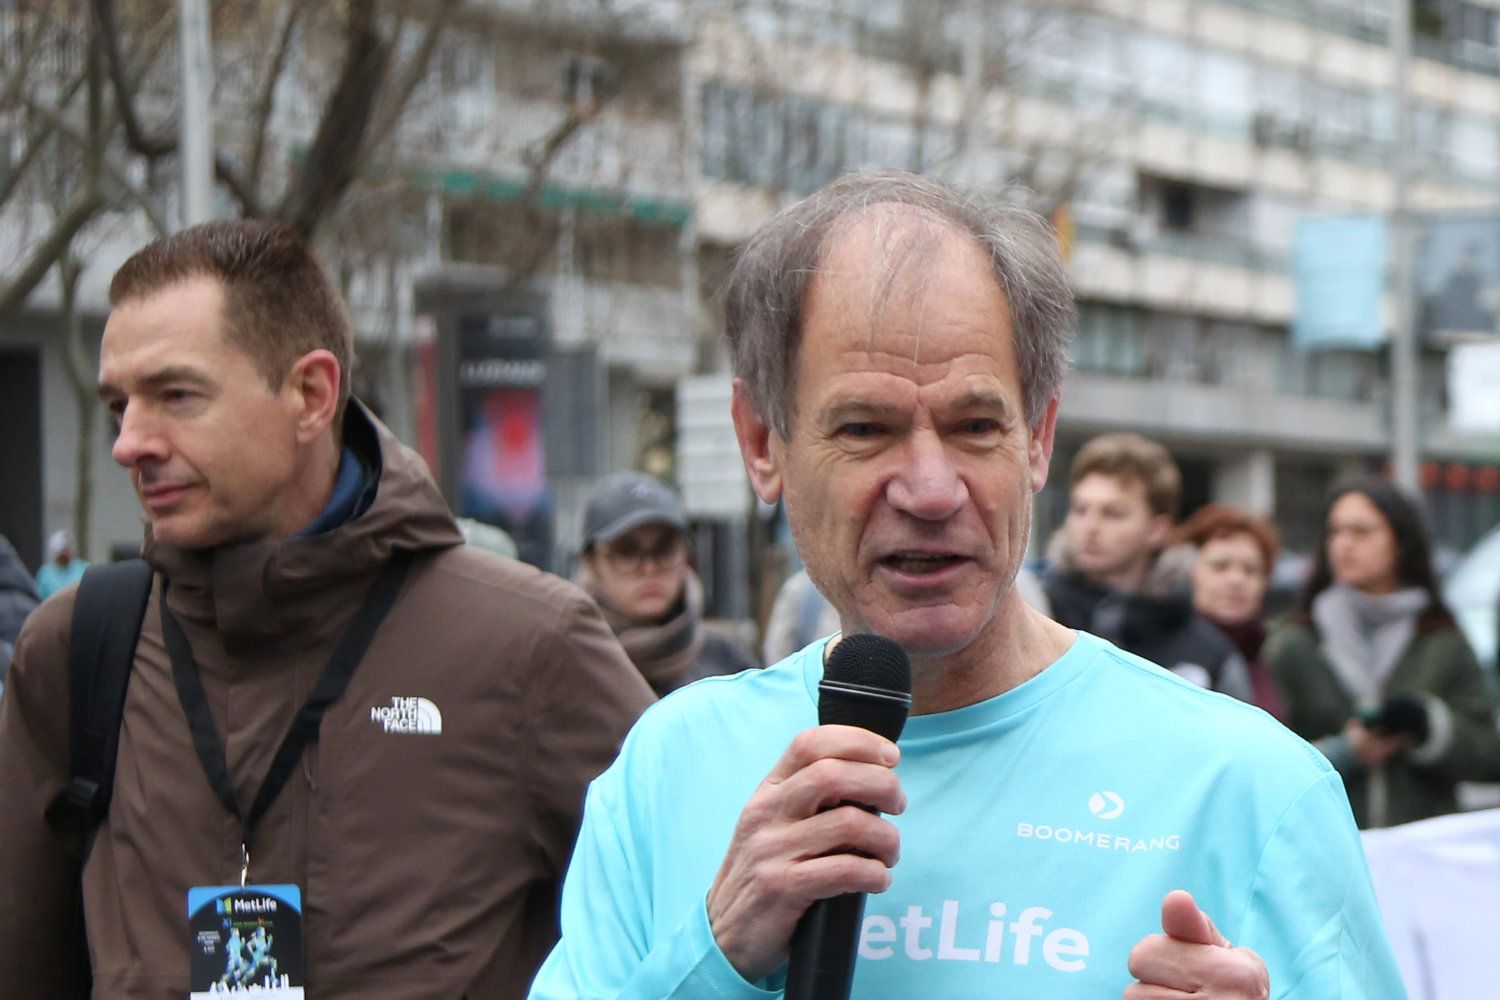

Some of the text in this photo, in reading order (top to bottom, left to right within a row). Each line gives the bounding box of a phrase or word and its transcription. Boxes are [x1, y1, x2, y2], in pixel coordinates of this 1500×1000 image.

[392, 696, 417, 708] THE
[371, 706, 417, 721] NORTH
[384, 719, 417, 733] FACE
[1017, 822, 1181, 852] BOOMERANG
[234, 899, 277, 913] MetLife
[857, 899, 1090, 973] etLife
